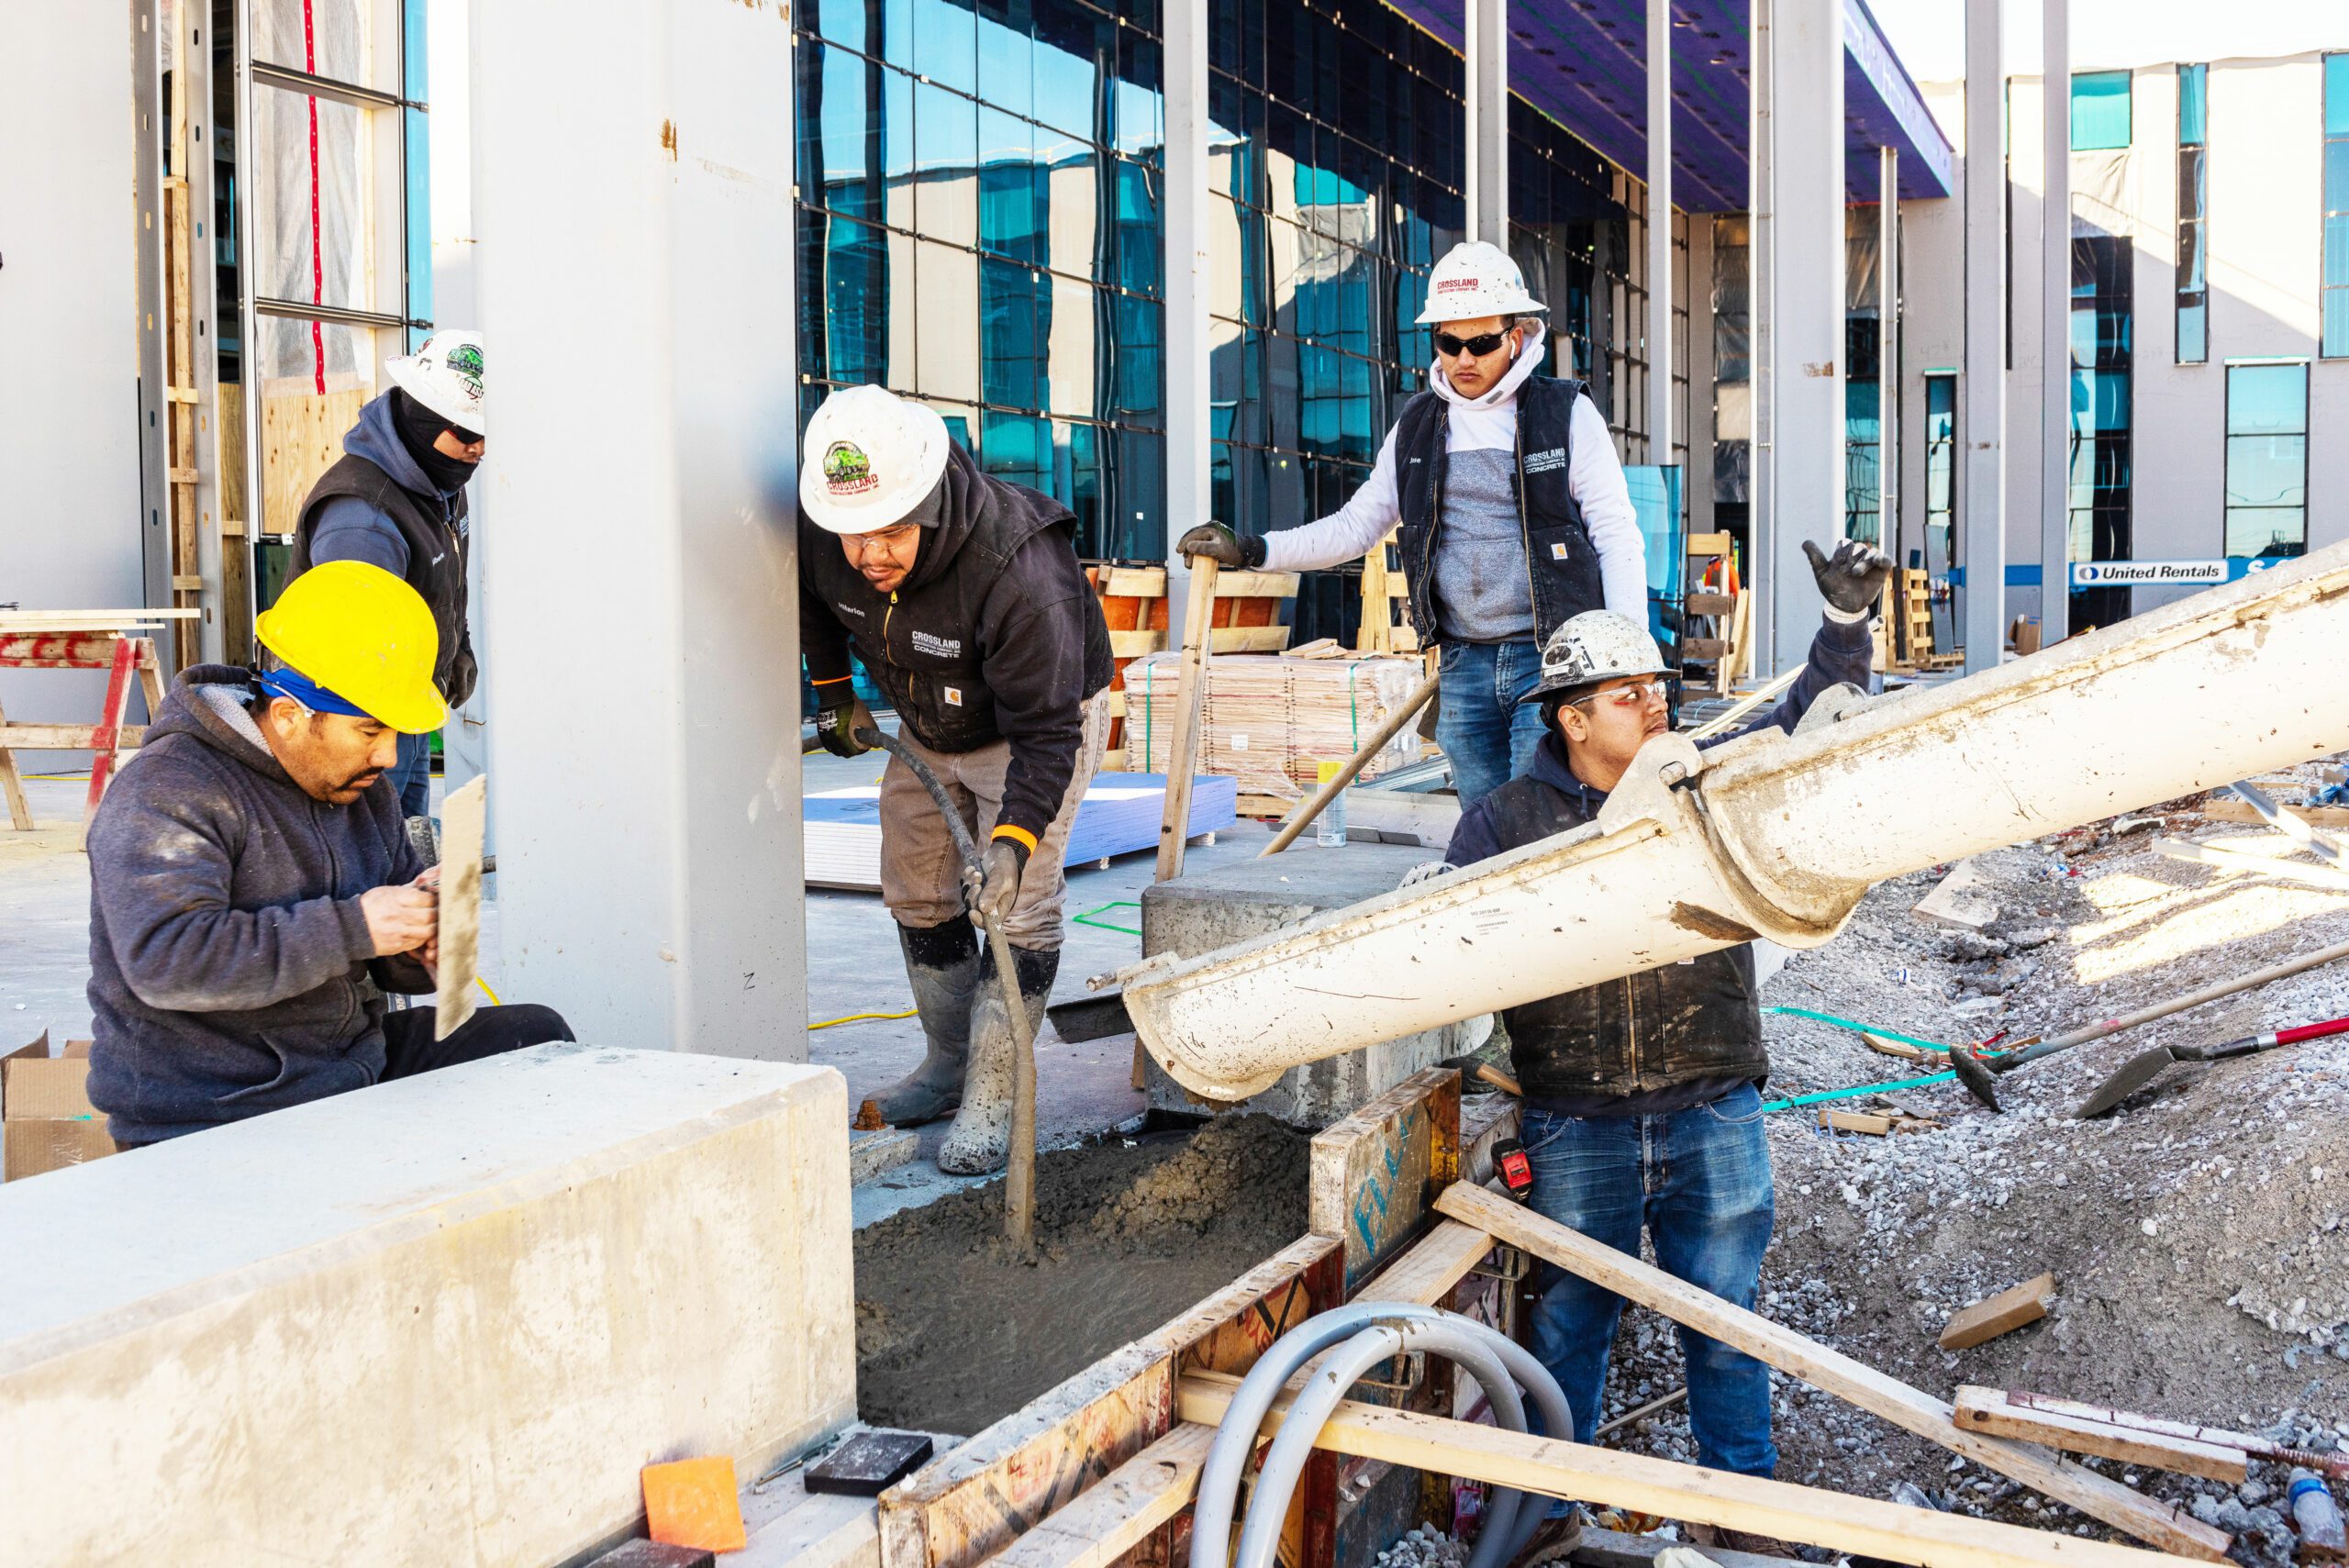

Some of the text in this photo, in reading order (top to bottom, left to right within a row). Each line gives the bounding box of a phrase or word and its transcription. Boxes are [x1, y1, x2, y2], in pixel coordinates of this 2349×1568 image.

[1437, 279, 1478, 289] CROSSLAND
[1523, 447, 1565, 464] CROSSLAND
[1526, 462, 1565, 474] CONCRETE
[827, 473, 879, 492] CROSSLAND
[2103, 564, 2220, 580] United Rentals
[911, 630, 961, 649] CROSSLAND
[914, 644, 960, 658] CONCRETE
